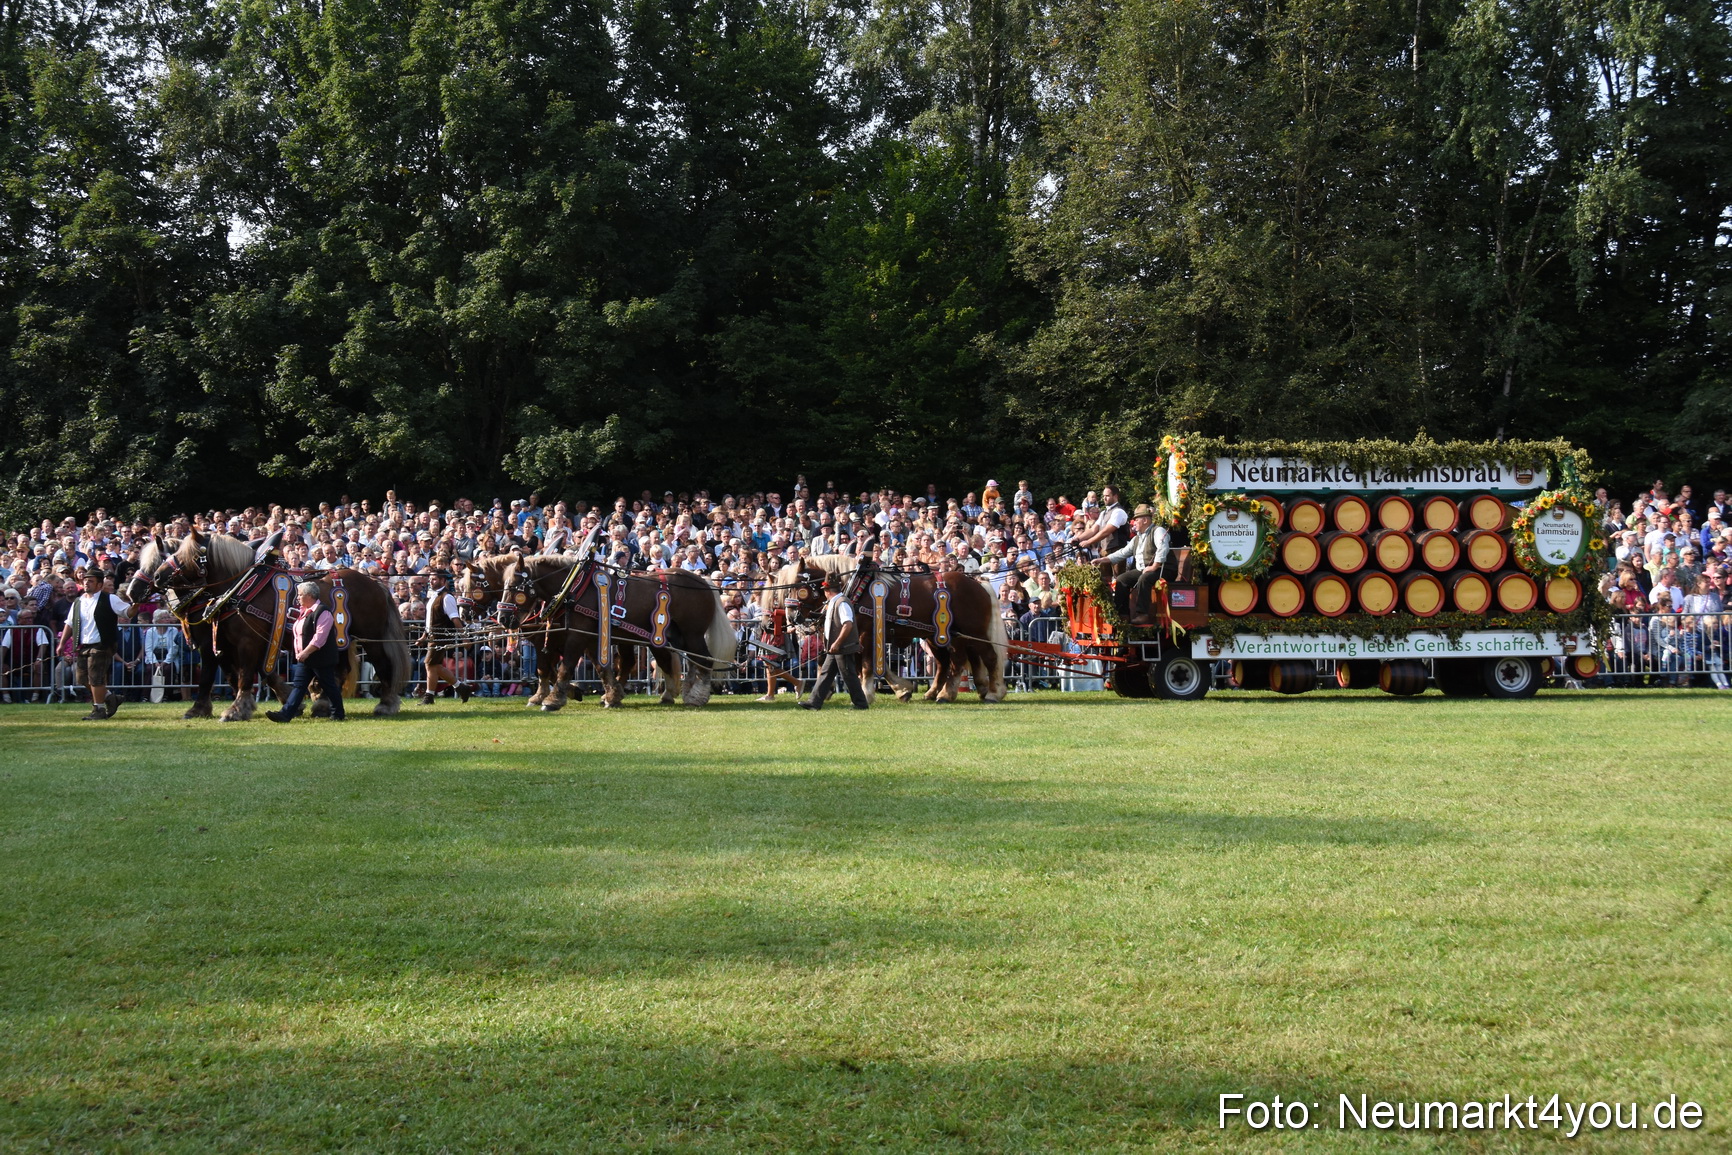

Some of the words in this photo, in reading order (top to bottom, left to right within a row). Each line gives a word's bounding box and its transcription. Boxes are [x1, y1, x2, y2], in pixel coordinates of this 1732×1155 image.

[1537, 528, 1579, 536] Lammsbräu
[1235, 639, 1357, 656] Verantwortung
[1362, 638, 1410, 653] leben.
[1414, 638, 1471, 652] Genuss
[1477, 637, 1549, 651] schaffen.
